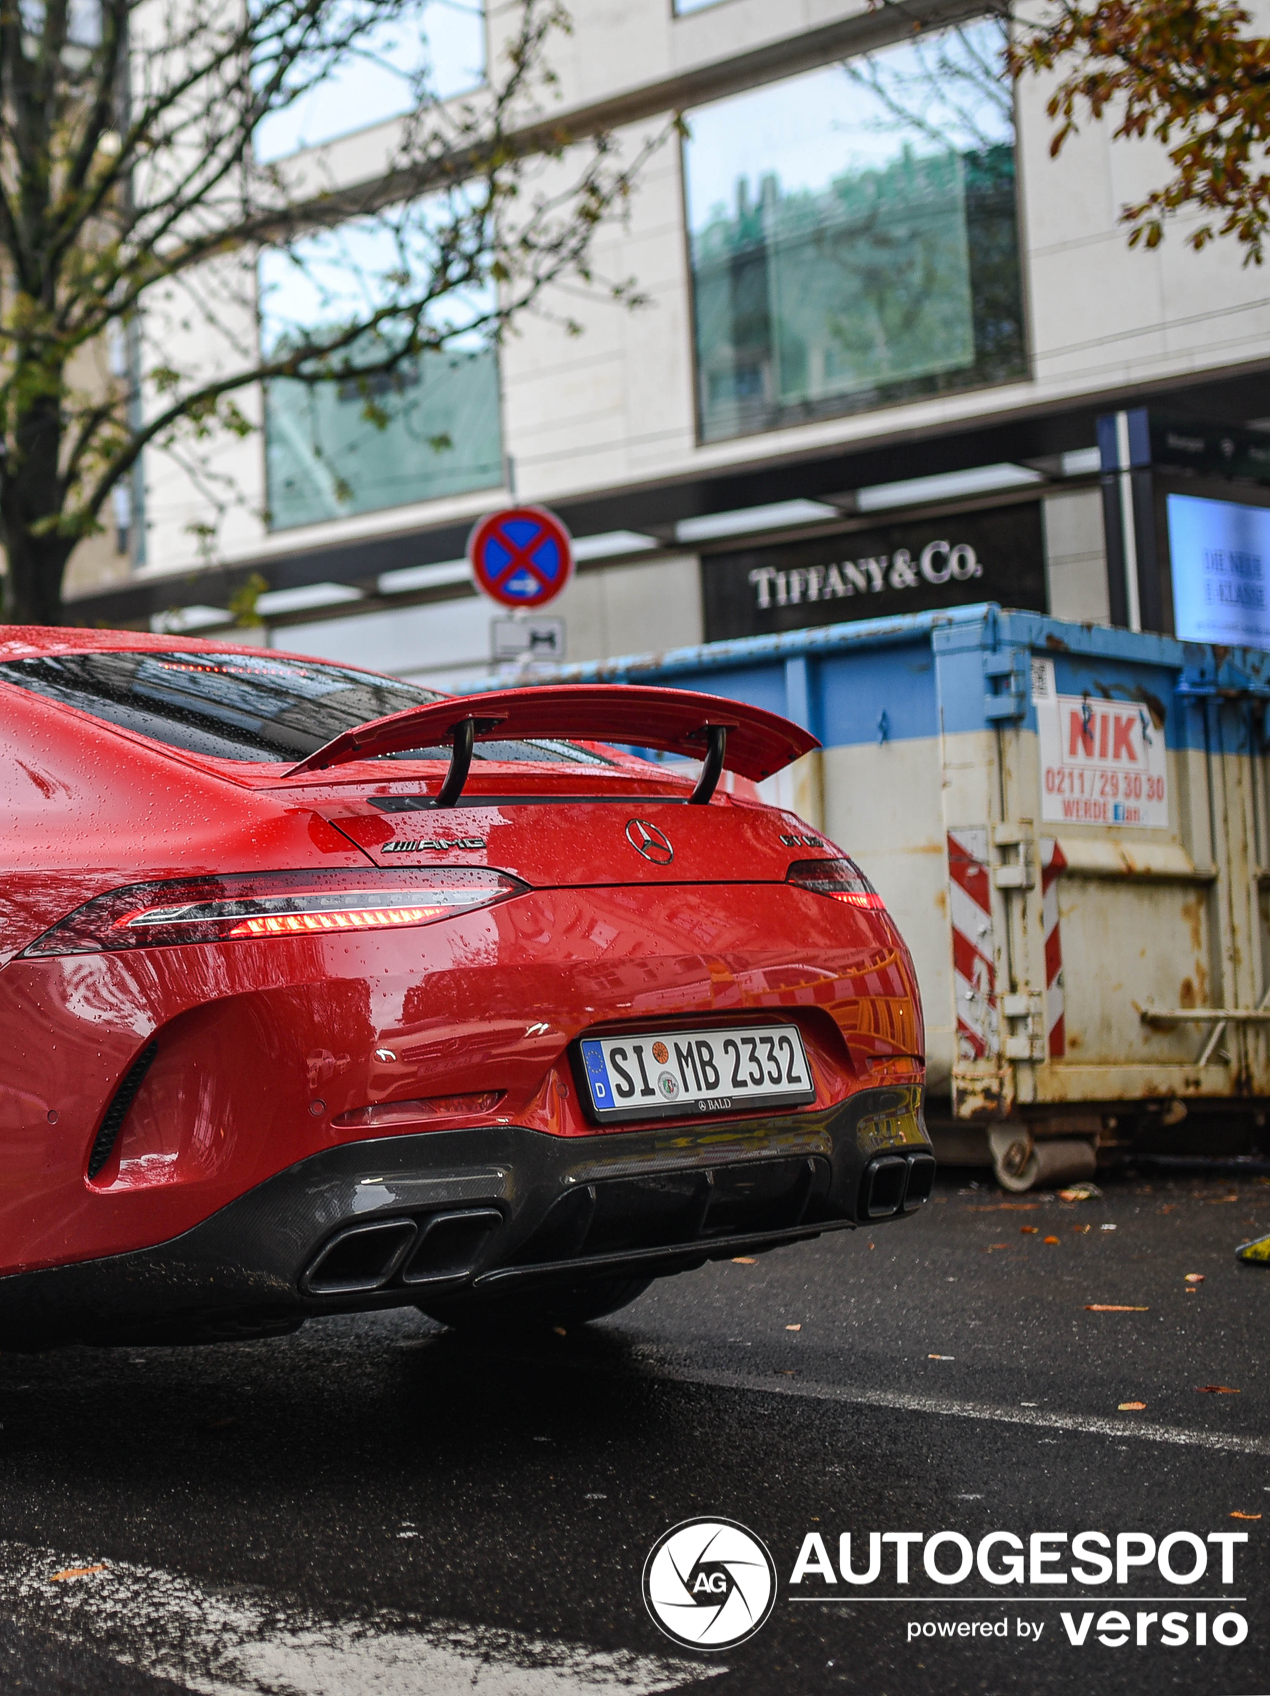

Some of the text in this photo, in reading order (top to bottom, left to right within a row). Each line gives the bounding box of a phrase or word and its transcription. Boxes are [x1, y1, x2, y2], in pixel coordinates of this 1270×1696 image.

[1069, 709, 1138, 761] NIK
[1062, 800, 1109, 821] WERDE
[609, 1044, 656, 1099] SI
[673, 1039, 721, 1093] MB
[722, 1034, 803, 1090] 2332
[595, 1082, 606, 1098] D
[707, 1098, 731, 1110] BALD
